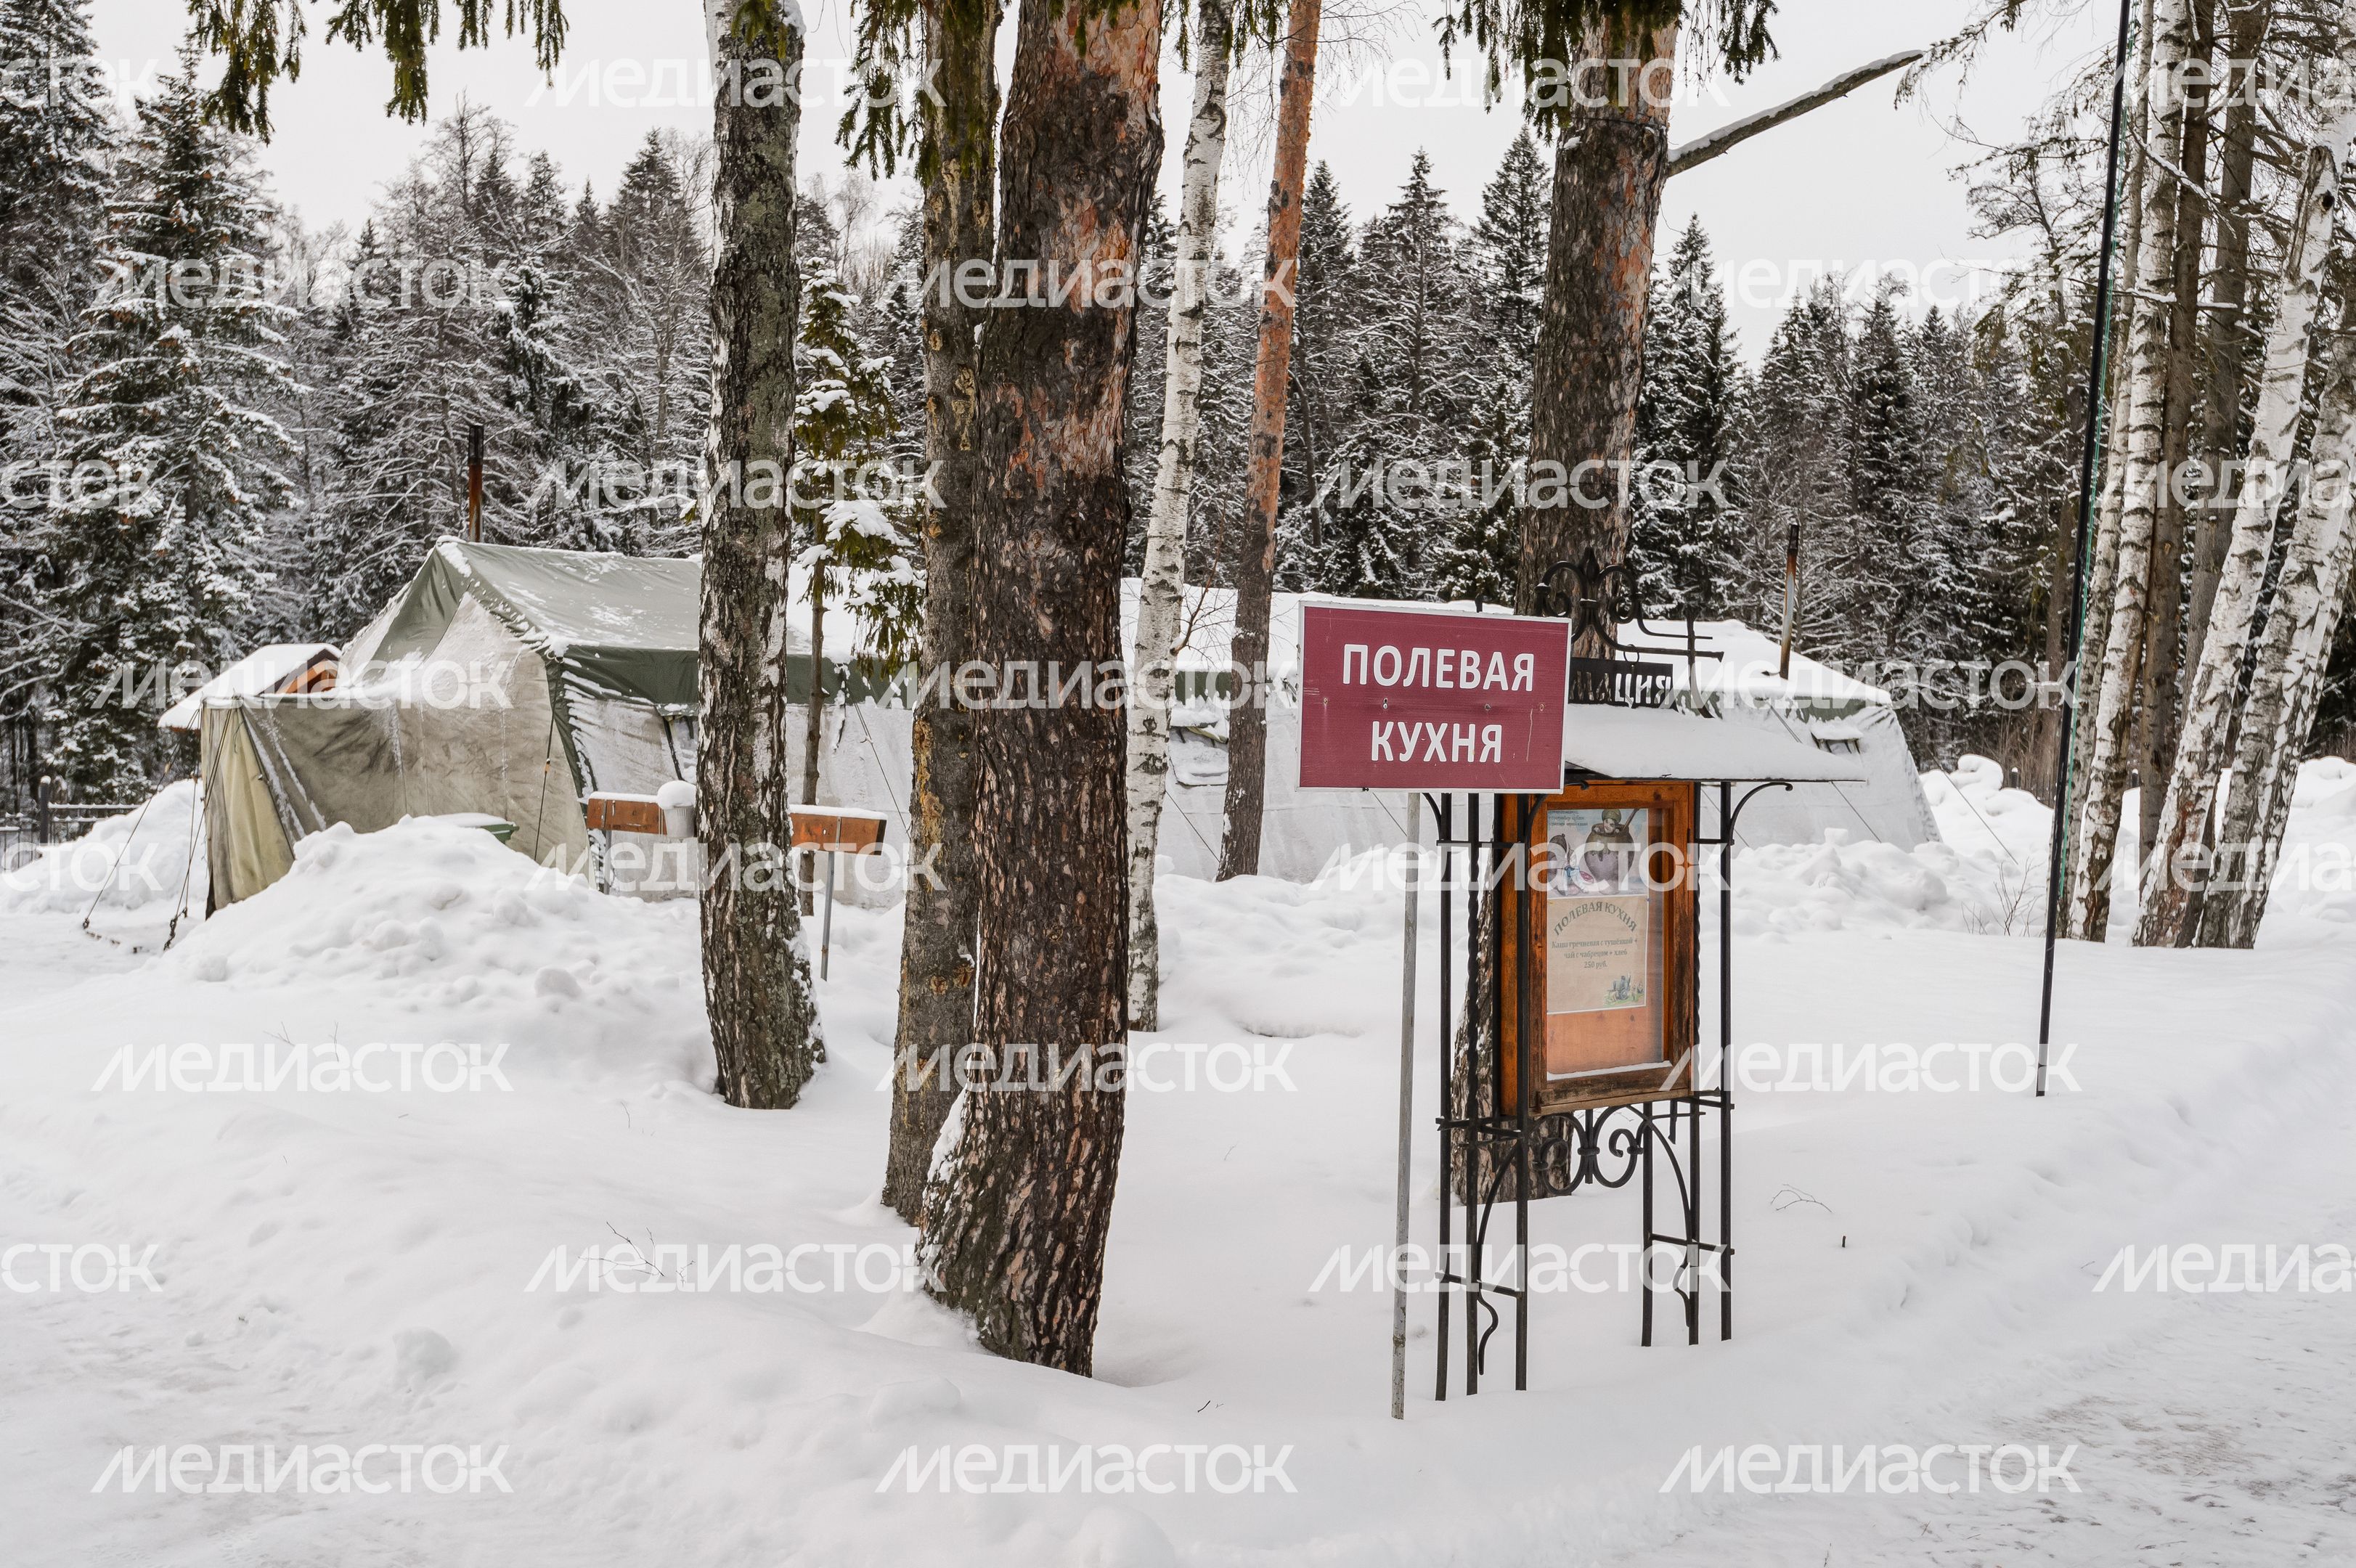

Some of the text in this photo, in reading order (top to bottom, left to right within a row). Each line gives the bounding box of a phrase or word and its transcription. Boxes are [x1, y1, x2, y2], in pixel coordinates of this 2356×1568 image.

[1343, 644, 1534, 691] ПОЛЕВАЯ
[1371, 721, 1502, 763] КУХНЯ
[1554, 901, 1637, 936] ПОЛЕВАЯ КУХНЯ
[1579, 950, 1608, 959] чабрецом
